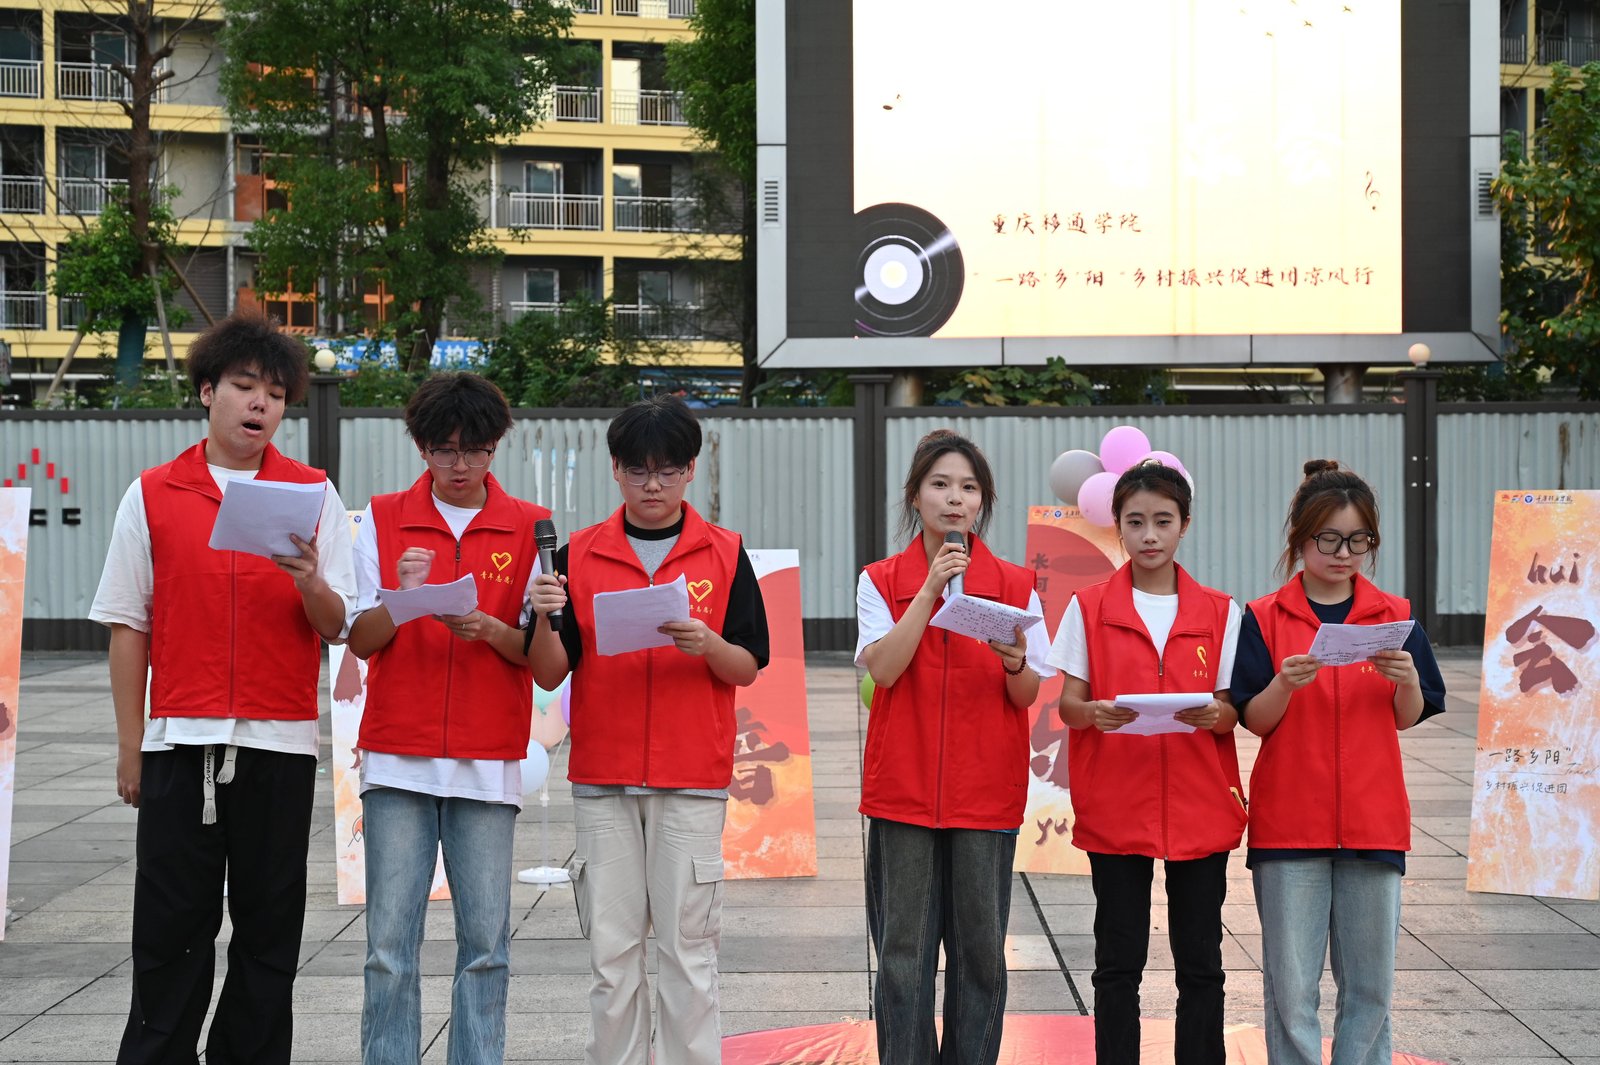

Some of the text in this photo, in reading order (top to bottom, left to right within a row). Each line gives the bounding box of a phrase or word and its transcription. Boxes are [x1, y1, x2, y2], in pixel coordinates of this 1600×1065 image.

[991, 212, 1142, 235] 重庆移通学院
[1527, 552, 1580, 584] hui
[1505, 605, 1596, 695] 会
[1486, 780, 1568, 795] 乡村振兴促进团
